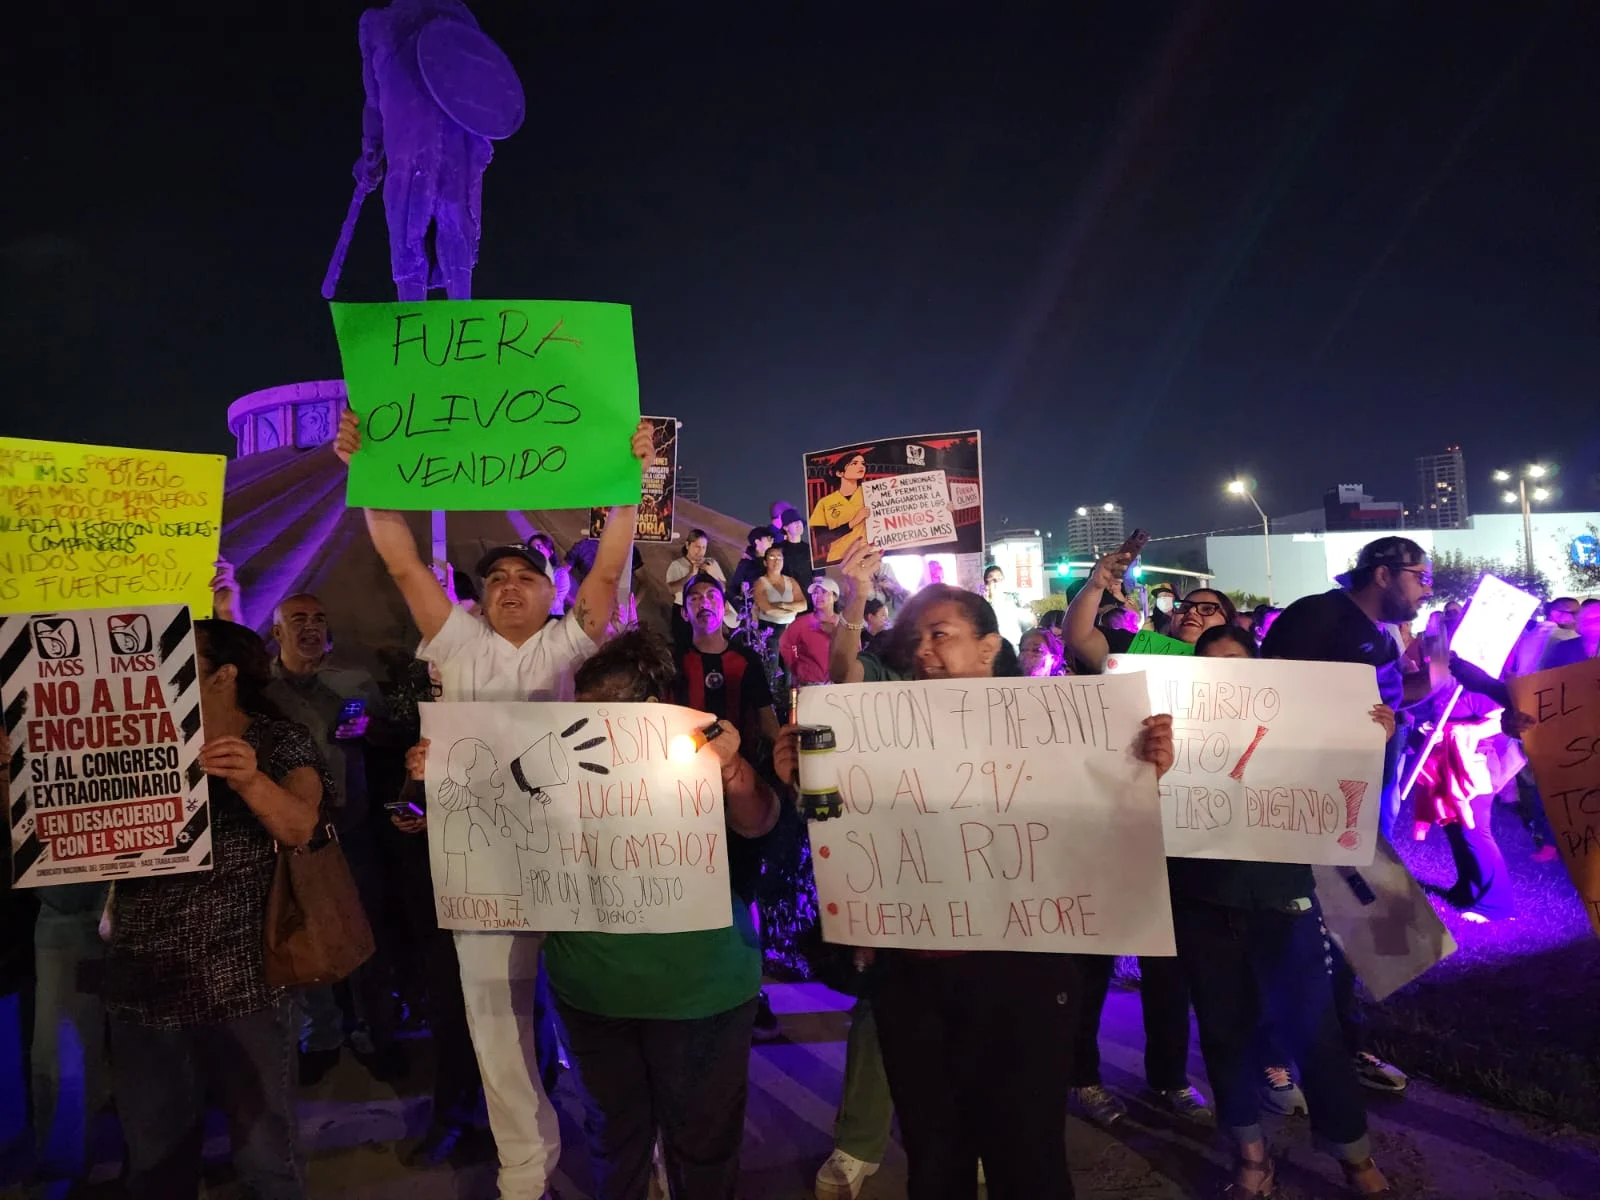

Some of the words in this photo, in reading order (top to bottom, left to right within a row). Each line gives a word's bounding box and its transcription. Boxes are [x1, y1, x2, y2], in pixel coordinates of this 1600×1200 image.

[391, 310, 584, 367] FUERA
[366, 384, 581, 442] OLIVOS
[110, 469, 184, 488] DIGNO
[397, 446, 567, 488] VENDIDO
[871, 482, 888, 493] MIS
[890, 478, 898, 489] 2
[871, 493, 929, 510] SALVAGUARDAR
[931, 491, 942, 499] LA
[872, 502, 918, 517] INTEGRIDAD
[920, 501, 928, 509] DE
[894, 485, 932, 496] PERMITEN
[930, 523, 953, 537] IMSS
[89, 549, 178, 573] SOMOS
[38, 658, 84, 678] IMSS
[110, 654, 156, 674] IMSS
[33, 680, 80, 717] NO
[91, 678, 114, 714] A
[123, 675, 167, 711] LA
[1534, 682, 1583, 725] EL
[27, 711, 178, 753] ENCUESTA
[823, 686, 936, 755] SECCION
[944, 688, 974, 750] 7
[985, 682, 1118, 752] PRESENTE
[31, 752, 49, 783] SÍ
[54, 755, 78, 780] AL
[82, 745, 179, 778] CONGRESO
[32, 770, 182, 808] EXTRAORDINARIO
[577, 777, 653, 820] LUCHA
[677, 779, 715, 817] NO
[890, 767, 939, 816] AL
[72, 802, 176, 832] DESACUERDO
[1244, 779, 1369, 850] DIGNO!
[56, 835, 88, 858] CON
[92, 833, 110, 852] EL
[113, 825, 169, 850] SNTSS!
[557, 831, 600, 868] HAY
[610, 832, 718, 875] CAMBIO!
[845, 829, 885, 894] SI
[896, 828, 944, 885] AL
[958, 821, 1049, 883] RJP
[558, 869, 580, 905] UN
[633, 875, 684, 908] JUSTO
[440, 895, 499, 921] SECCION
[505, 897, 524, 920] 7
[480, 918, 531, 929] TIJUANA
[570, 908, 580, 926] Y
[597, 909, 638, 926] DIGNO
[846, 899, 936, 937] FUERA
[948, 901, 983, 938] EL
[1002, 894, 1101, 939] AFORE
